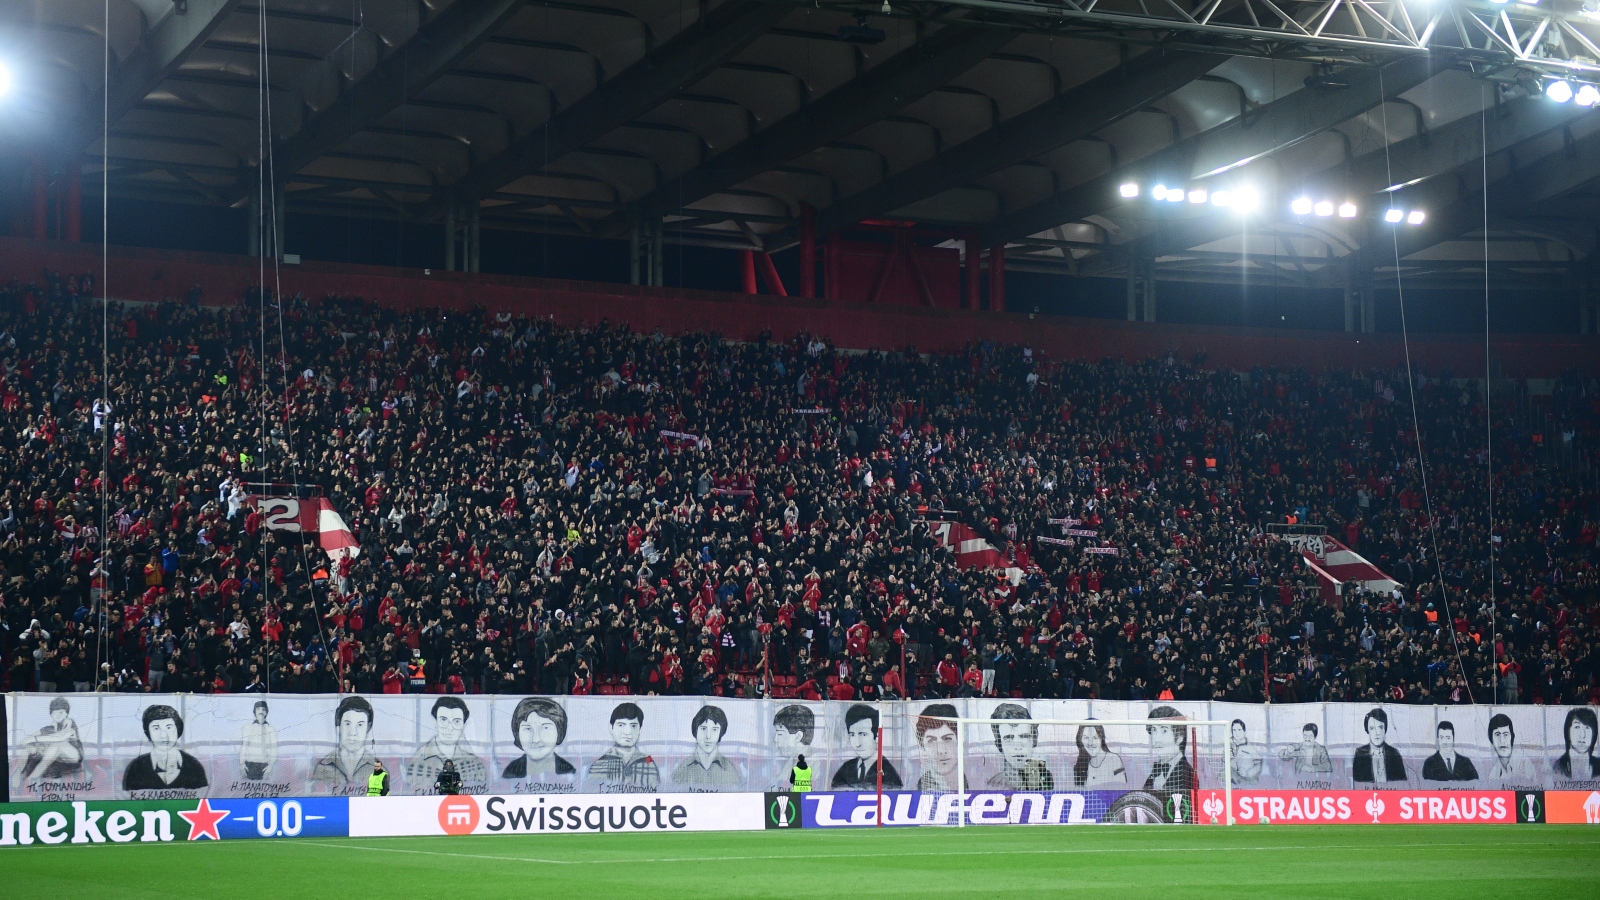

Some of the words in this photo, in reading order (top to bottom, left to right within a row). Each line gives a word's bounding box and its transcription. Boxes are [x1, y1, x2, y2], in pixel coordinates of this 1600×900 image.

[0, 801, 175, 845] neken
[257, 799, 302, 837] 0.0
[486, 796, 687, 832] Swissquote
[1239, 796, 1351, 820] STRAUSS
[1399, 796, 1507, 820] STRAUSS
